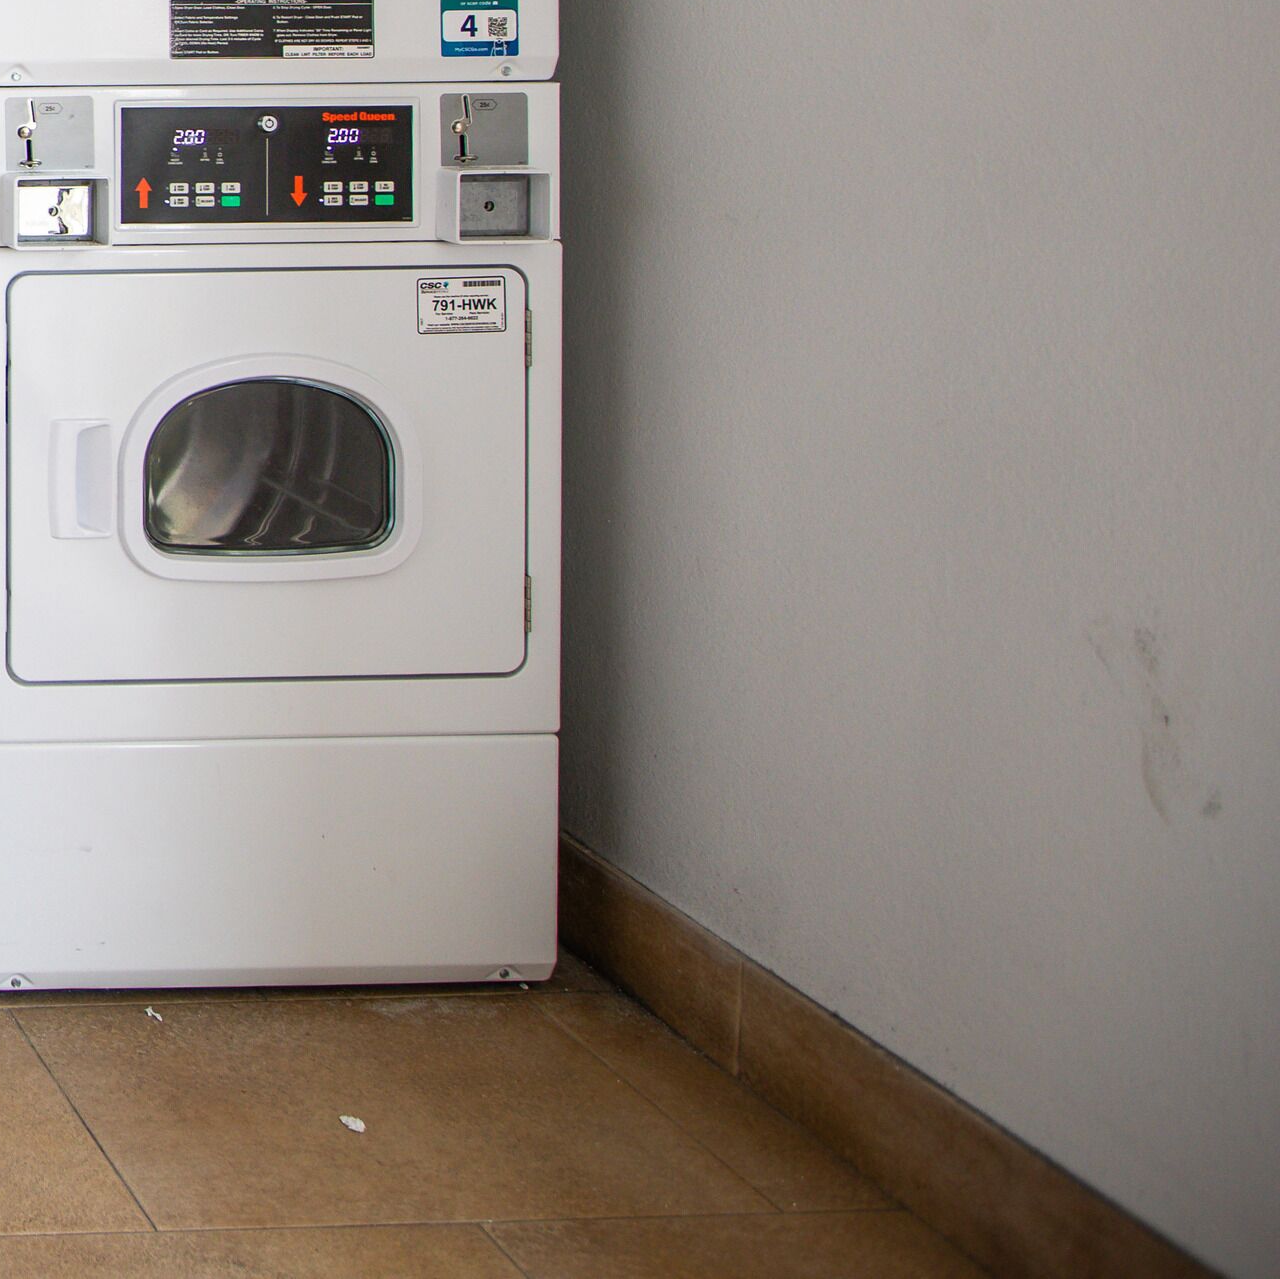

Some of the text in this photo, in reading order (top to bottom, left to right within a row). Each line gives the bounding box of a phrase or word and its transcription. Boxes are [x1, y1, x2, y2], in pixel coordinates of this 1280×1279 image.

[460, 15, 478, 37] 4
[322, 112, 395, 123] Speed Queen
[327, 128, 359, 143] 2.00
[432, 298, 497, 311] 791-HWK
